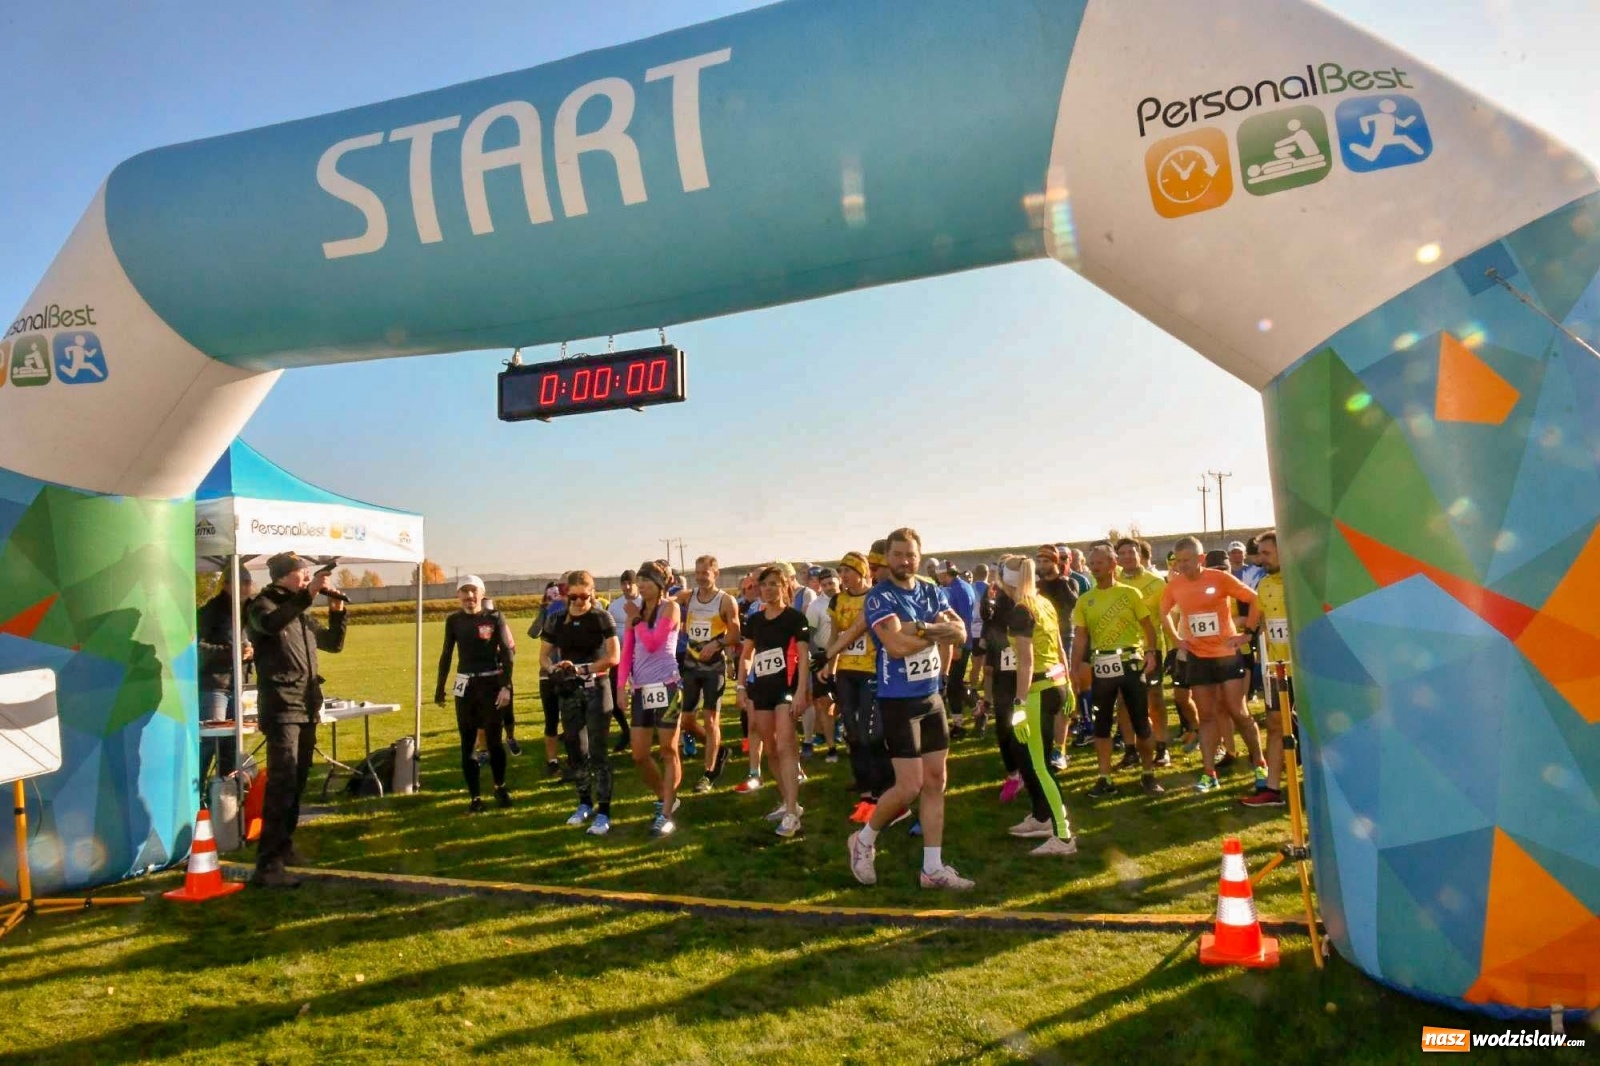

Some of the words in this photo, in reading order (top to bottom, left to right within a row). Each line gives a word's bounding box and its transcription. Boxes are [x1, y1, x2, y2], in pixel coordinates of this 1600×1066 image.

[1136, 62, 1414, 137] PersonalBest
[316, 47, 732, 259] START
[540, 360, 667, 405] 0:00:00
[251, 518, 327, 537] PersonalBest
[690, 627, 710, 638] 197
[1190, 620, 1216, 633] 181
[756, 657, 783, 672] 179
[908, 657, 939, 676] 222
[1095, 662, 1121, 675] 206
[642, 691, 666, 705] 148
